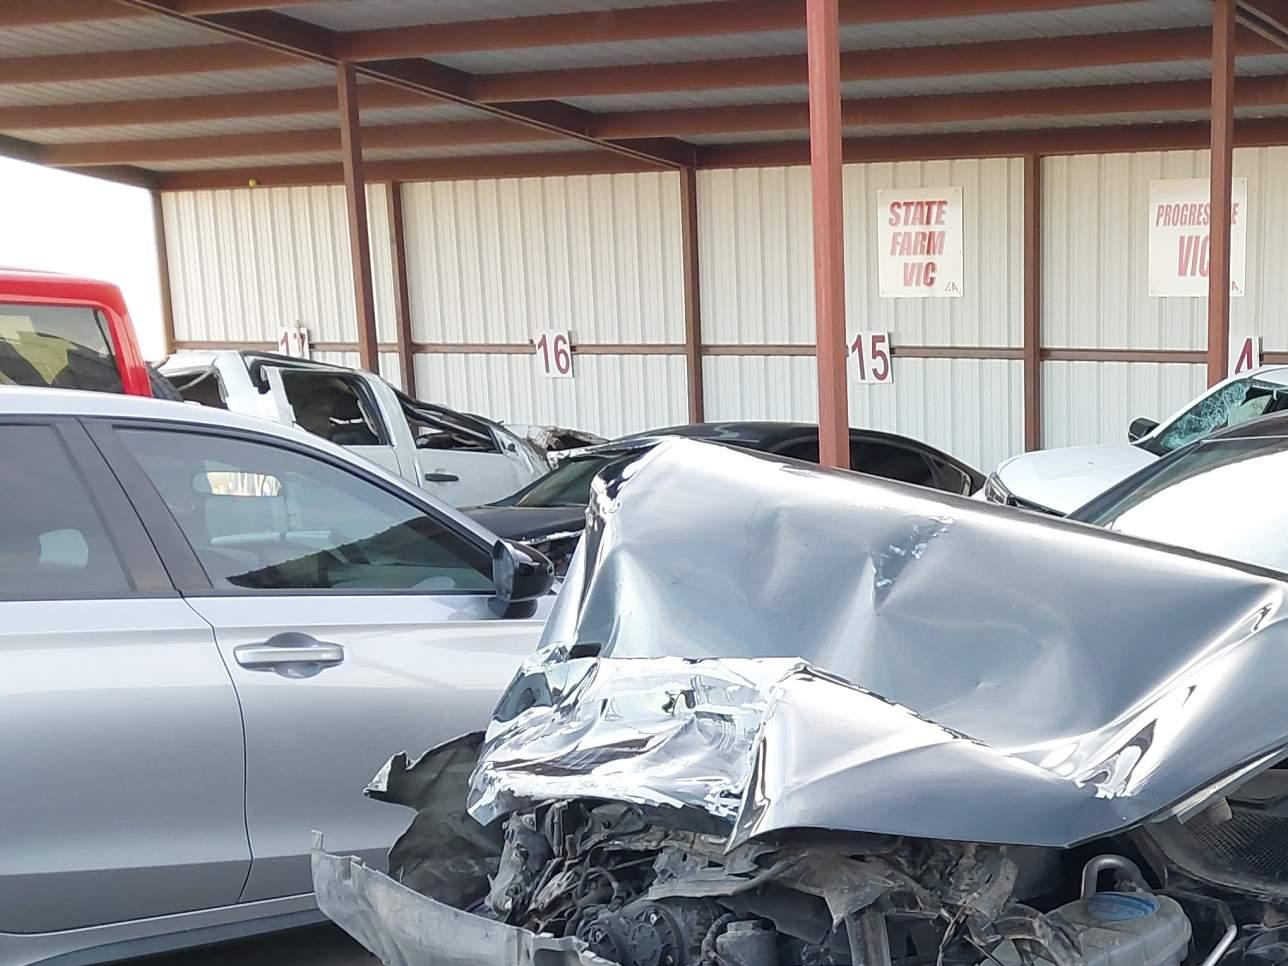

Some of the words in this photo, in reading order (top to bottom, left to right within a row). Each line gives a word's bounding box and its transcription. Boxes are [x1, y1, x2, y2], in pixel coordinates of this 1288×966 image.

[888, 200, 948, 226] STATE
[1156, 203, 1240, 226] PROGRESE
[890, 230, 946, 256] FARM
[903, 261, 937, 287] VIC
[537, 334, 570, 374] 16
[851, 334, 889, 381] 15
[1234, 338, 1253, 375] 4
